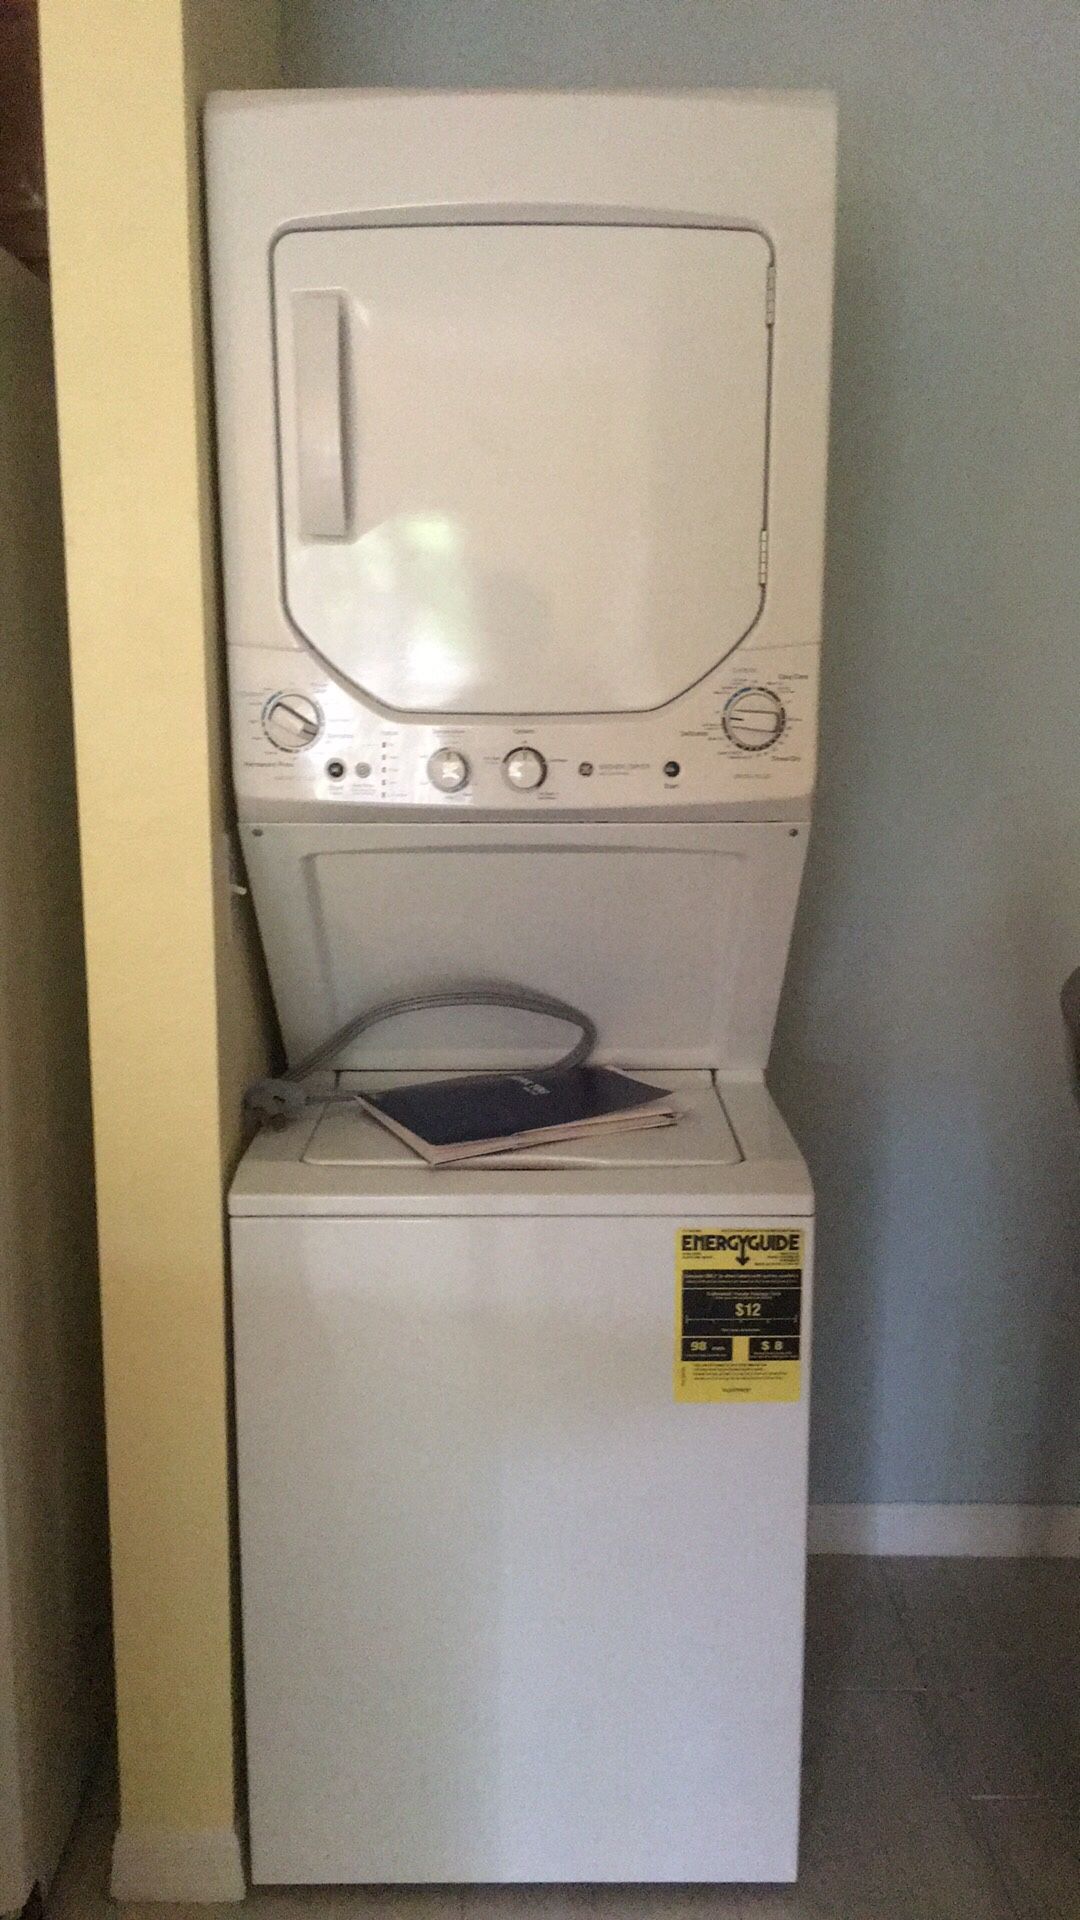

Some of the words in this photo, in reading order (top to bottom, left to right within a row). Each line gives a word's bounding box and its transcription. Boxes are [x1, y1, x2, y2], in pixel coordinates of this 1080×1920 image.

[682, 1234, 800, 1251] ENERGYGUIDE
[735, 1303, 761, 1317] $12
[761, 1341, 770, 1350] $
